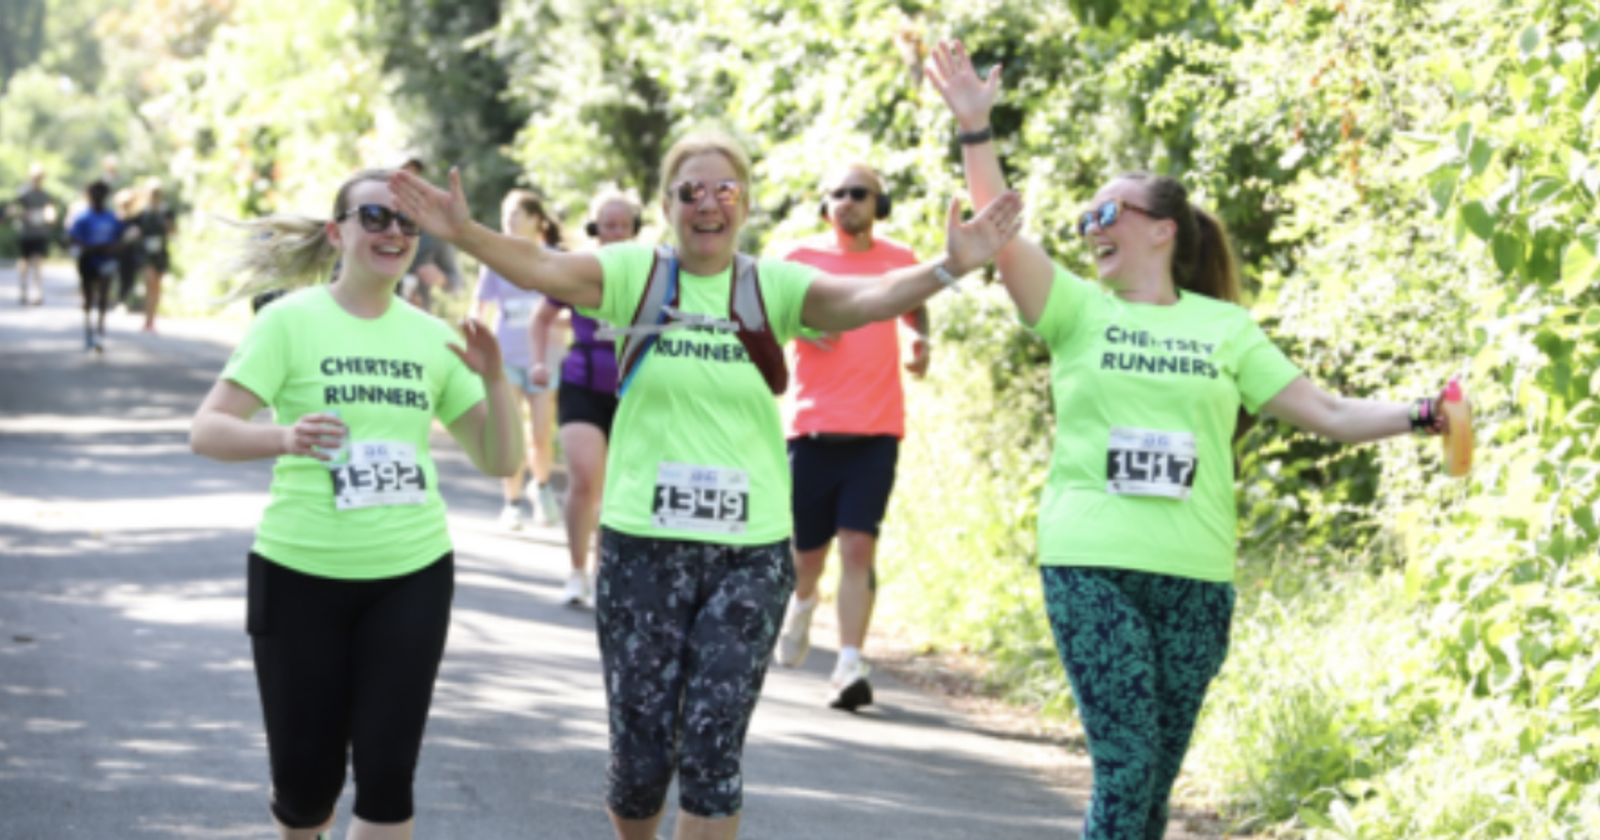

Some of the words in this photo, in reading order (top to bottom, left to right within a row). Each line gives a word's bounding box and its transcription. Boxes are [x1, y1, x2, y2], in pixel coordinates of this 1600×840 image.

[654, 338, 752, 363] RUNNER
[320, 356, 424, 382] CHERTSEY
[1101, 352, 1219, 379] RUNNERS
[323, 384, 429, 411] RUNNERS
[336, 462, 420, 494] 1392
[1114, 449, 1194, 485] 1417
[655, 484, 744, 521] 1349
